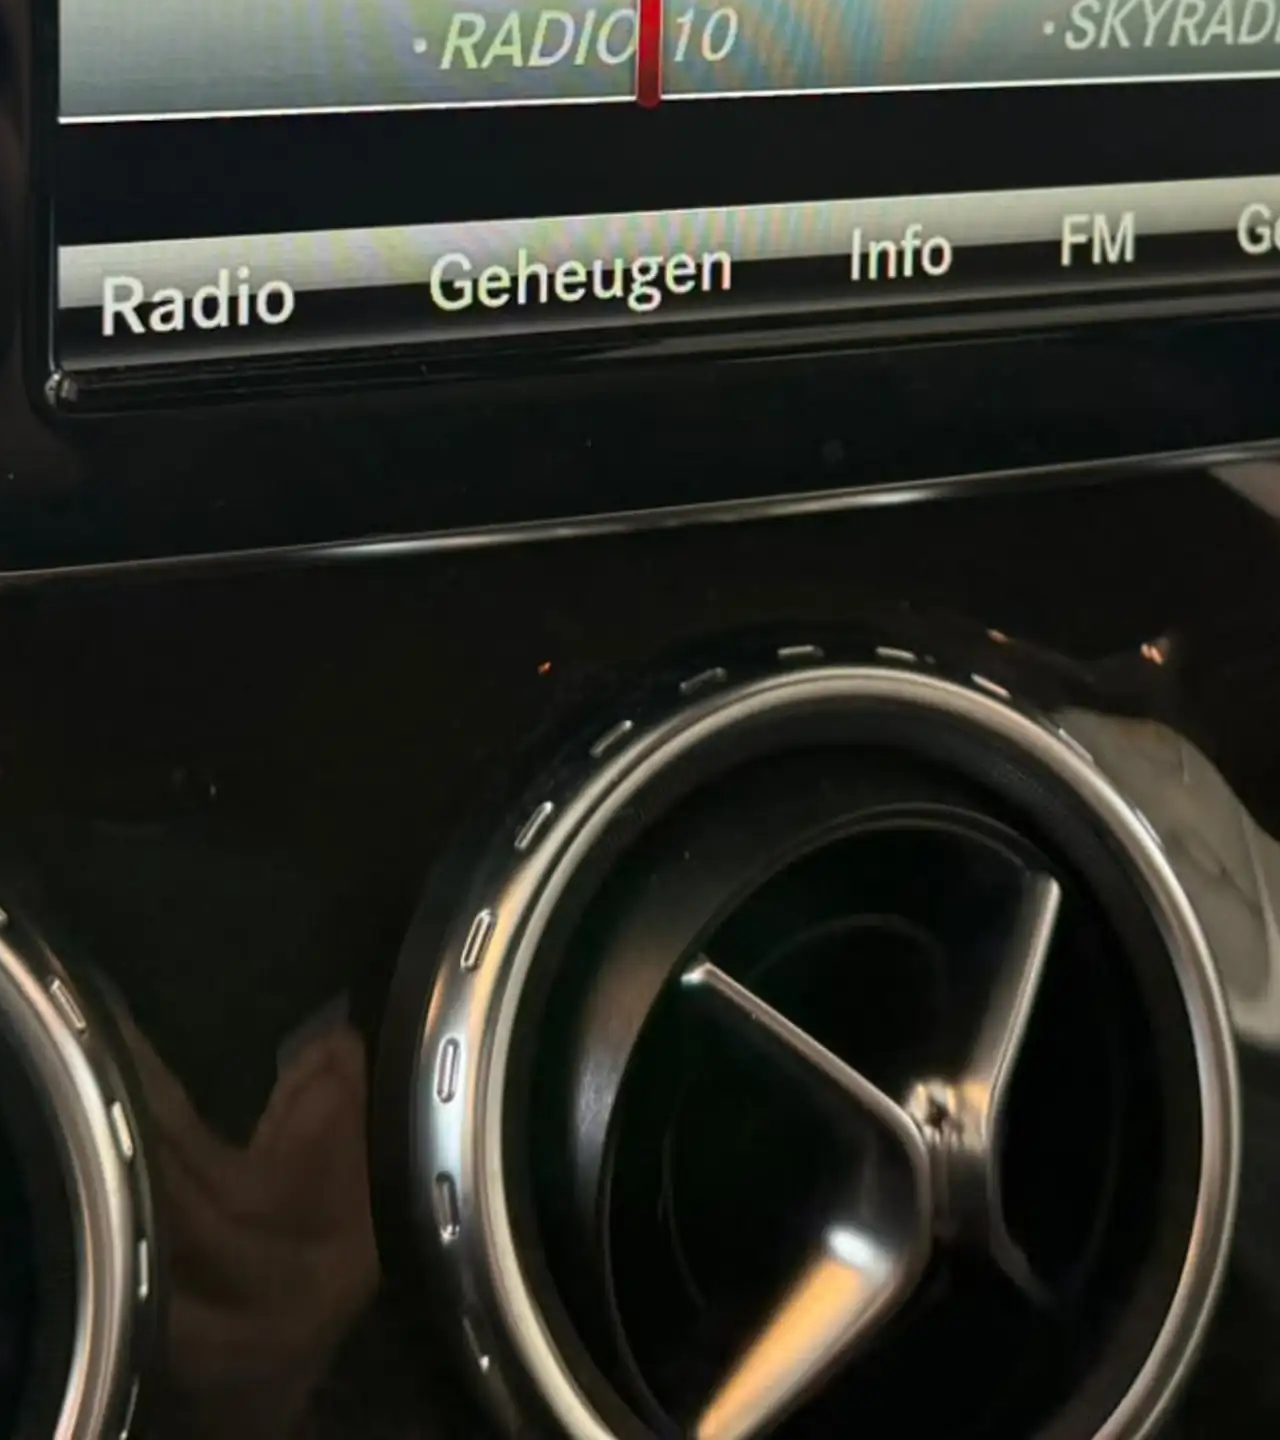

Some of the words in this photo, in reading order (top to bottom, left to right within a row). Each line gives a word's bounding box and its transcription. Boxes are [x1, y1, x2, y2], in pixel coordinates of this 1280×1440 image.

[438, 10, 639, 71] RADIO
[673, 6, 739, 62] 10
[101, 266, 296, 337] Radio
[428, 248, 733, 312] Geheugen
[849, 224, 954, 281] Info
[1060, 212, 1136, 267] FM
